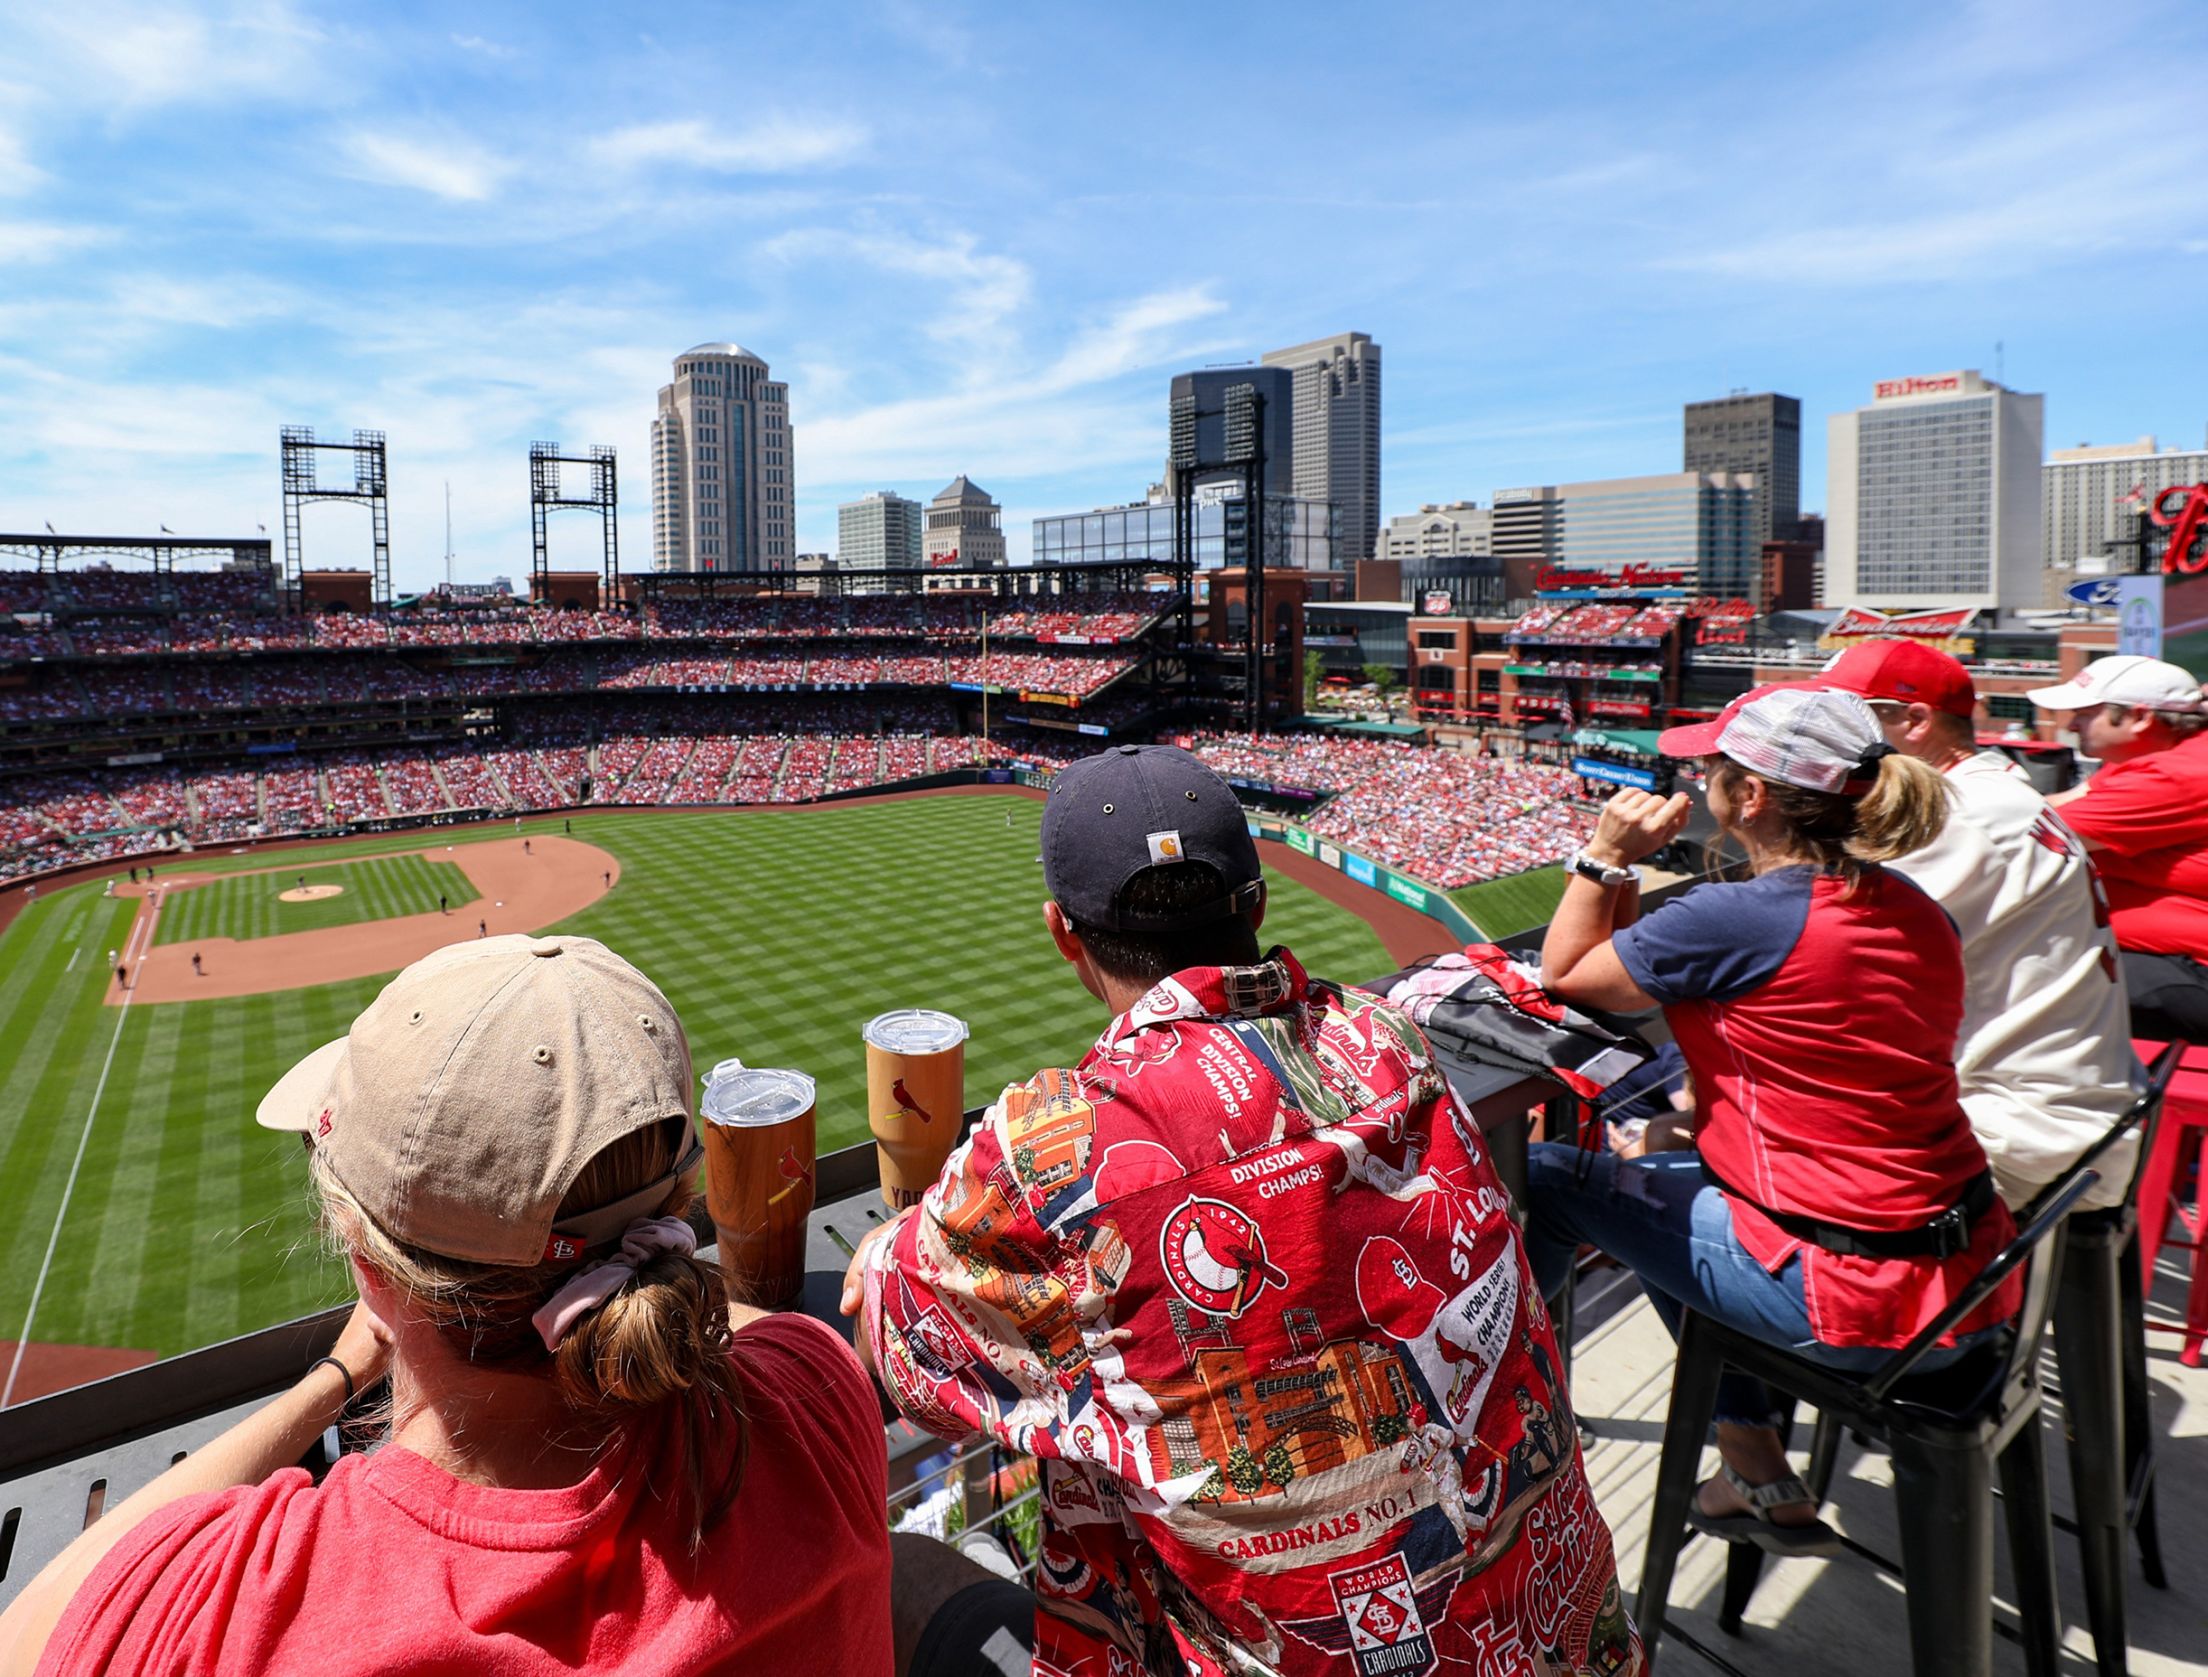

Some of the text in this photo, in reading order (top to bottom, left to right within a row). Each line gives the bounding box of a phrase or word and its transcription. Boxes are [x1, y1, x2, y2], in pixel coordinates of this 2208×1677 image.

[1876, 377, 1957, 398] Hilton
[675, 682, 866, 693] TAKE YOUR BASE
[1200, 1043, 1253, 1102] DIVISION
[1208, 1027, 1258, 1083] CENTRAL
[1196, 1057, 1242, 1119] CHAMPS!
[1230, 1147, 1305, 1184] DIVISION
[1258, 1163, 1325, 1199] CHAMPS!
[1169, 1208, 1248, 1304] CARDINALS 1942
[1450, 1218, 1477, 1281] ST.
[1461, 1285, 1491, 1325] WORLD
[1477, 1278, 1510, 1346] CHAMPIONS
[1218, 1488, 1418, 1560] CARDINALS NO. 1
[1341, 1571, 1402, 1596] CHAMPIONS
[1345, 1565, 1394, 1586] WORLD
[1363, 1640, 1427, 1676] CARDINALS
